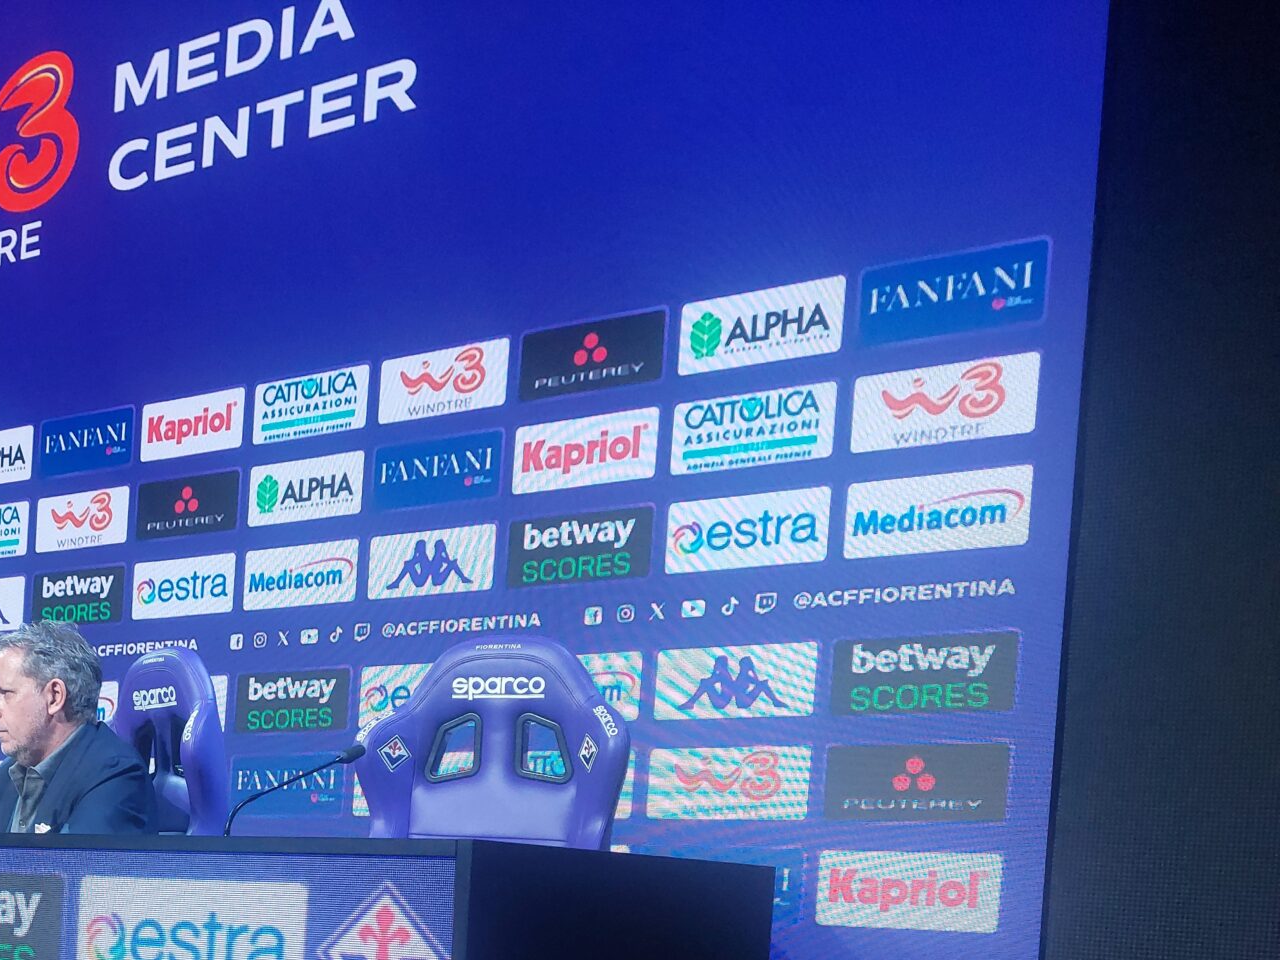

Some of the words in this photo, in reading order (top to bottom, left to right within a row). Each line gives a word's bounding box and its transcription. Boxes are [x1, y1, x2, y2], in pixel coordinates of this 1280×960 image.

[113, 0, 355, 112] MEDIA
[108, 58, 418, 191] CENTER
[868, 260, 1033, 315] FANFANI
[724, 303, 830, 348] ALPHA
[263, 372, 357, 406] CATTOLICA
[535, 362, 644, 390] PEUTEREY
[262, 396, 357, 419] ASSICURAZIONI
[408, 397, 472, 417] WINDTRE
[684, 390, 819, 430] CATTOLICA
[45, 421, 126, 454] FANFANI
[683, 418, 820, 446] ASSICURAZIONI
[893, 423, 985, 446] WINDTRE
[381, 448, 493, 485] FANFANI
[281, 472, 353, 505] ALPHA
[147, 513, 224, 530] PEUTEREY
[706, 510, 819, 552] estra
[853, 500, 1007, 539] Mediacom
[57, 534, 103, 548] WINDTRE
[524, 518, 636, 552] betway
[249, 567, 342, 592] Mediacom
[522, 552, 631, 583] SCORES
[42, 575, 113, 597] betway
[157, 571, 227, 602] estra
[793, 578, 1015, 609] @ACFFIORENTINA
[42, 602, 110, 623] SCORES
[381, 612, 541, 639] @ACFFIORENTINA
[93, 639, 198, 656] CFFIORENTINA
[475, 643, 522, 651] FIORENTINA
[851, 641, 996, 678] betway
[132, 685, 177, 710] sparco
[249, 676, 335, 702] betway
[452, 673, 545, 699] sparco
[849, 682, 989, 714] SCORES
[247, 707, 333, 730] SCORES
[593, 703, 618, 738] sparco
[237, 769, 335, 790] FANFANI
